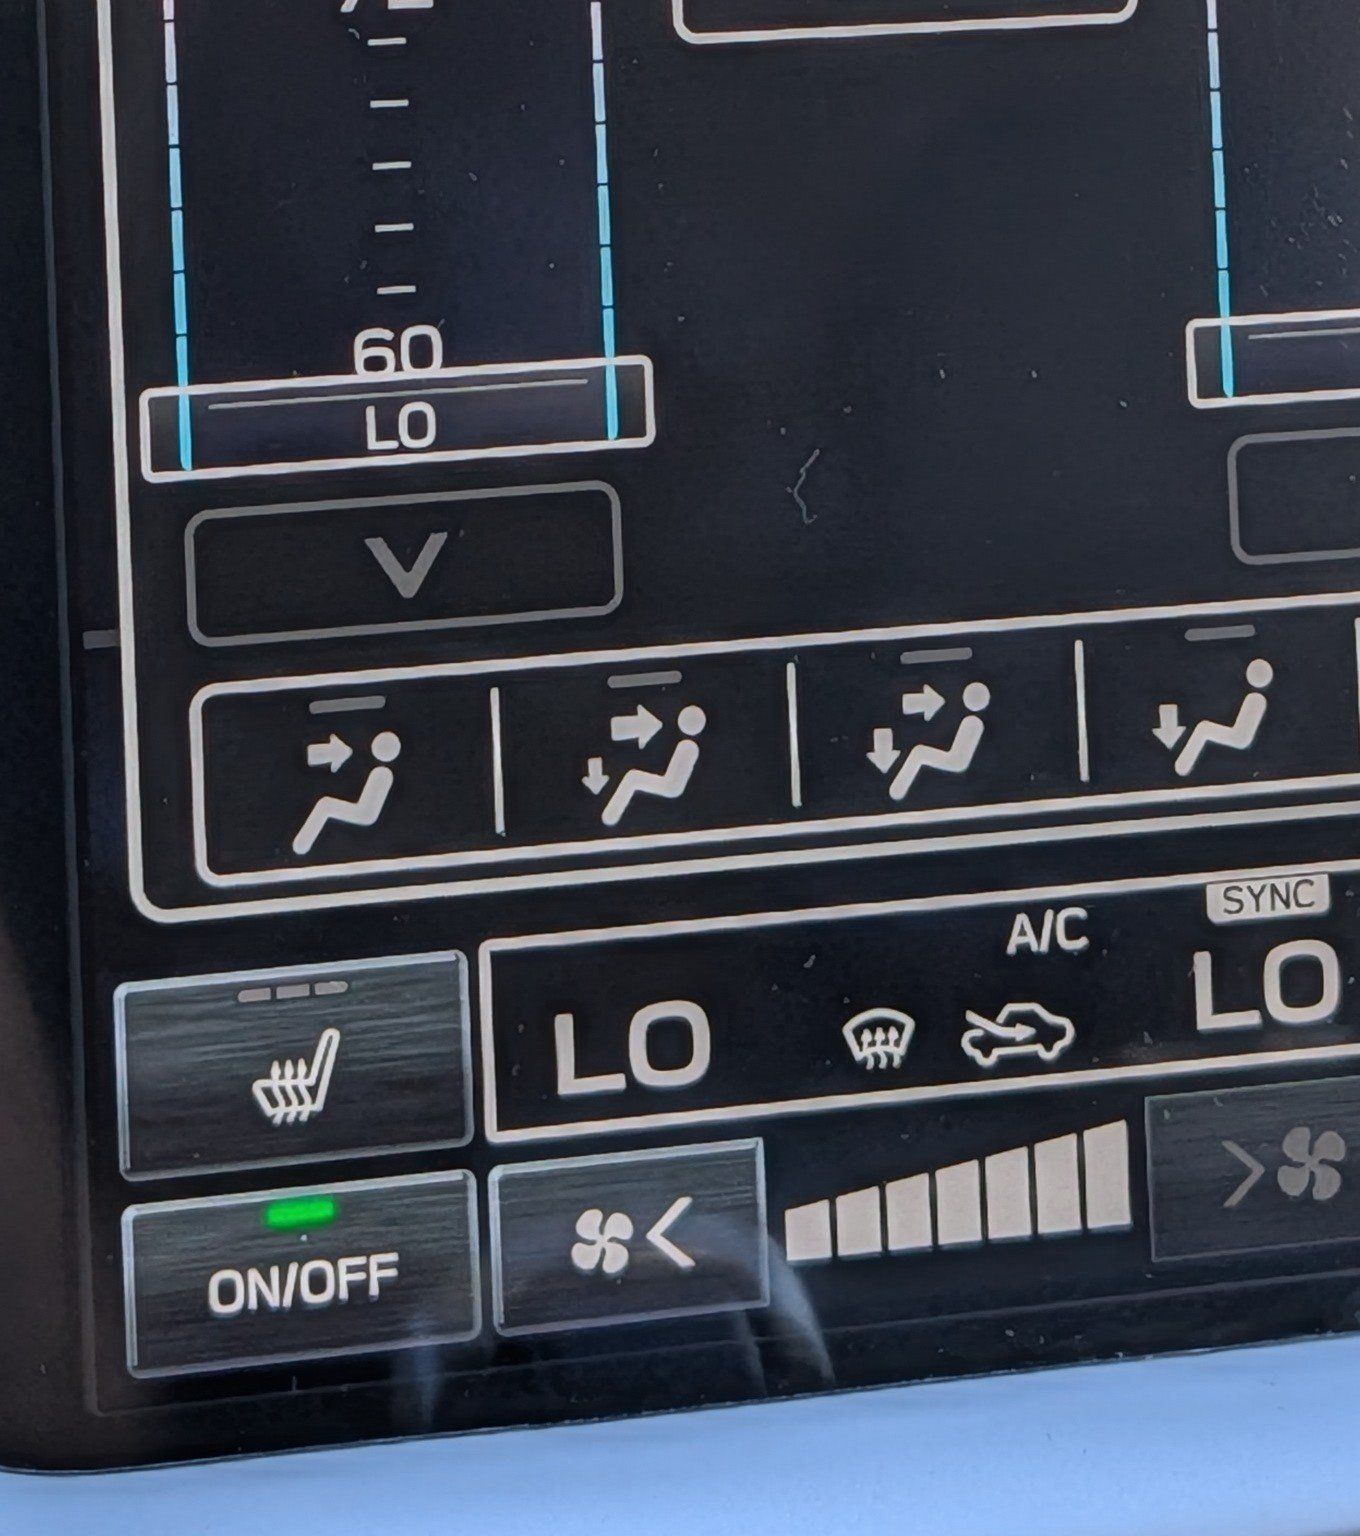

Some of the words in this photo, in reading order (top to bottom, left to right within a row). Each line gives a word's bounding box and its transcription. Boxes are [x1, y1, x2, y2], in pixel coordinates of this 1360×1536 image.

[351, 324, 444, 376] 60
[362, 400, 440, 452] LO
[1220, 878, 1318, 916] SYNC
[1005, 907, 1092, 957] A/C
[1192, 938, 1343, 1034] LO
[552, 997, 712, 1098] LO
[206, 1247, 401, 1319] ON/OFF
